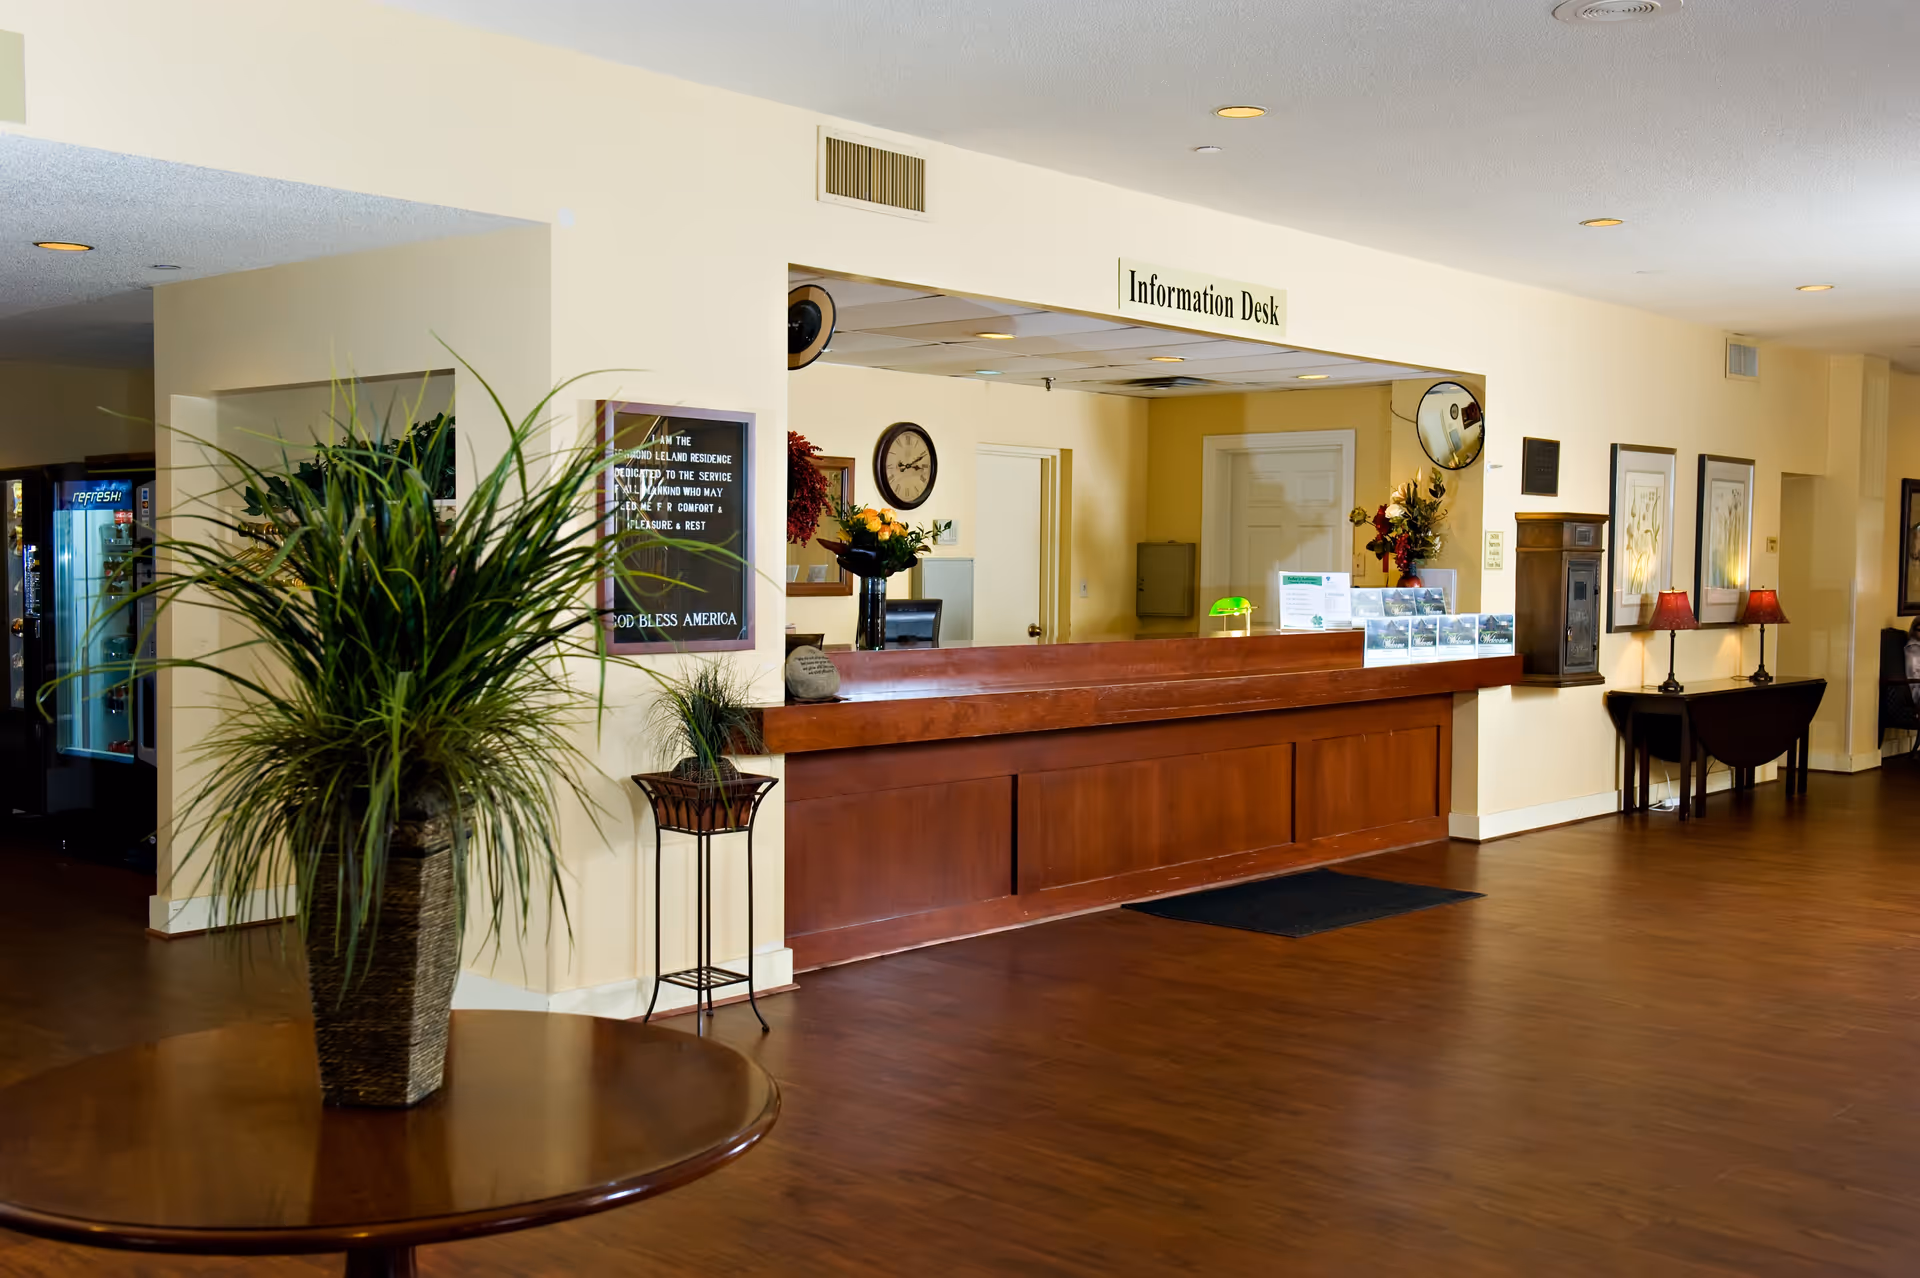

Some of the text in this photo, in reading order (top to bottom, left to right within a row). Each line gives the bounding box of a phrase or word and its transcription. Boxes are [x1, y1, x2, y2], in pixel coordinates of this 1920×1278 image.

[1129, 269, 1279, 326] Information Desk
[651, 434, 692, 446] I AM THE
[655, 451, 688, 462] LELAND
[690, 452, 732, 464] RESIDENCE
[614, 467, 733, 482] DEDICATED TO THE SERVICE
[682, 486, 702, 497] WHO
[703, 487, 724, 498] MAY
[640, 501, 652, 512] ME
[677, 502, 714, 513] COMFORT
[717, 505, 723, 514] &
[629, 519, 706, 531] PLEASURE & REST
[639, 613, 678, 628] BLESS
[683, 611, 737, 627] AMERICA
